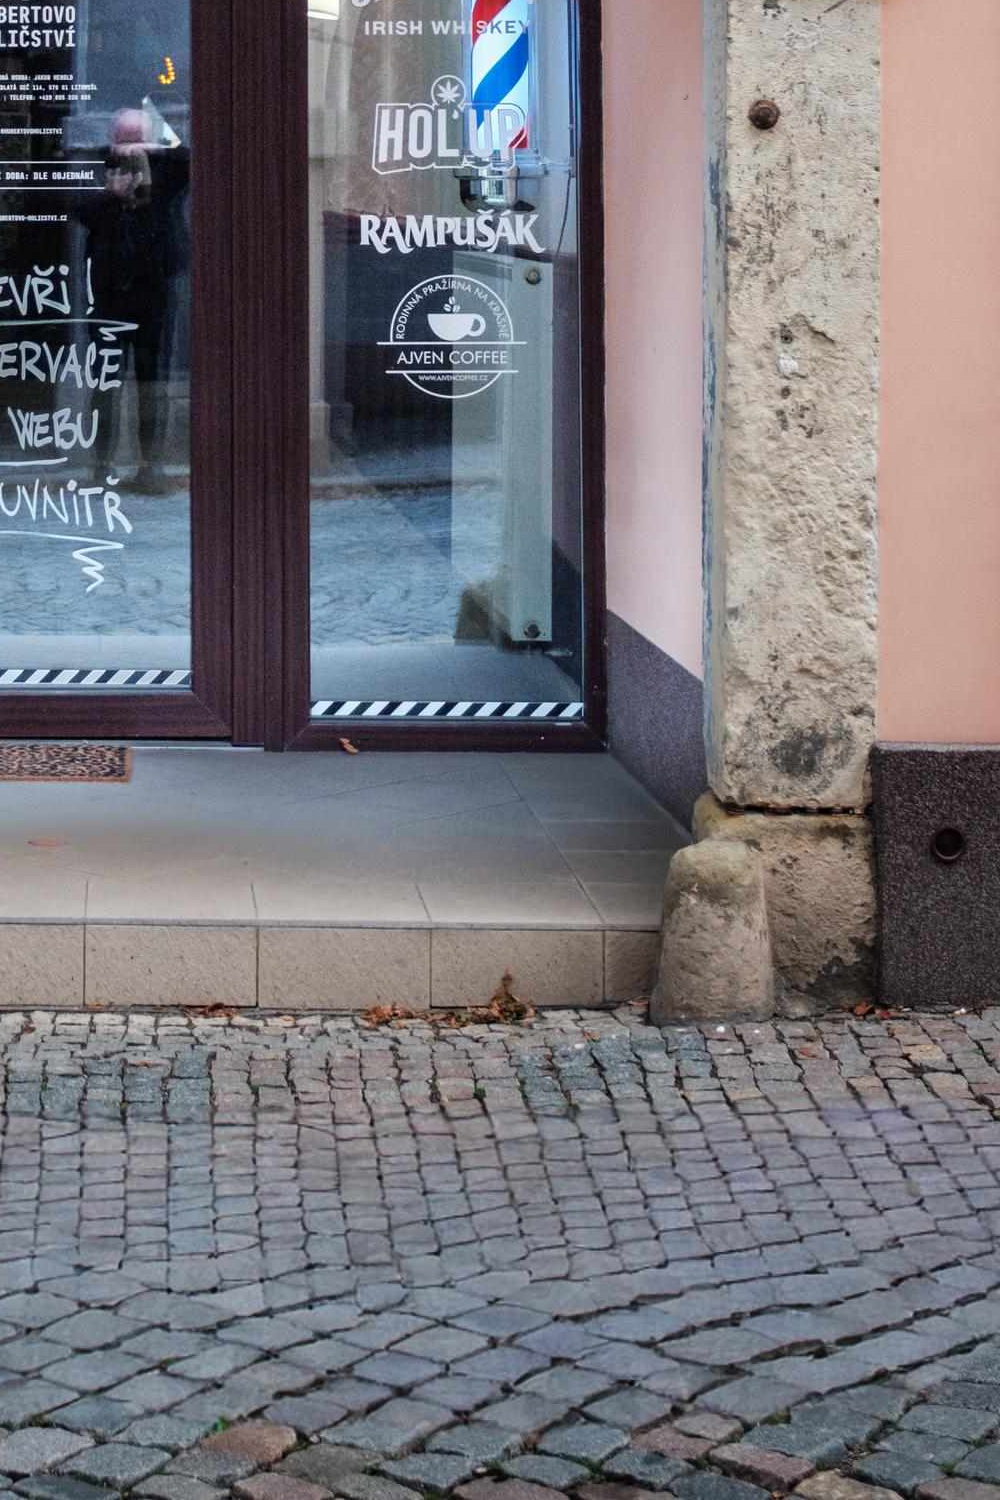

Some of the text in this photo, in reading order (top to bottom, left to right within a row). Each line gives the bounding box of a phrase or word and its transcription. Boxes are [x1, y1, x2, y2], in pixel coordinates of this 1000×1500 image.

[364, 20, 530, 35] IRISH WHISKEY
[5, 171, 29, 180] DOBA:
[33, 171, 48, 180] DLE
[52, 170, 95, 180] OBJEDNÁNÍ
[359, 208, 547, 254] RAMPUŠÁK
[395, 278, 510, 340] RODINNÁ PRAŽÍRNA NA KRÁSNÉ
[396, 350, 508, 364] AJVEN COFFEE
[7, 406, 99, 450] WEBU
